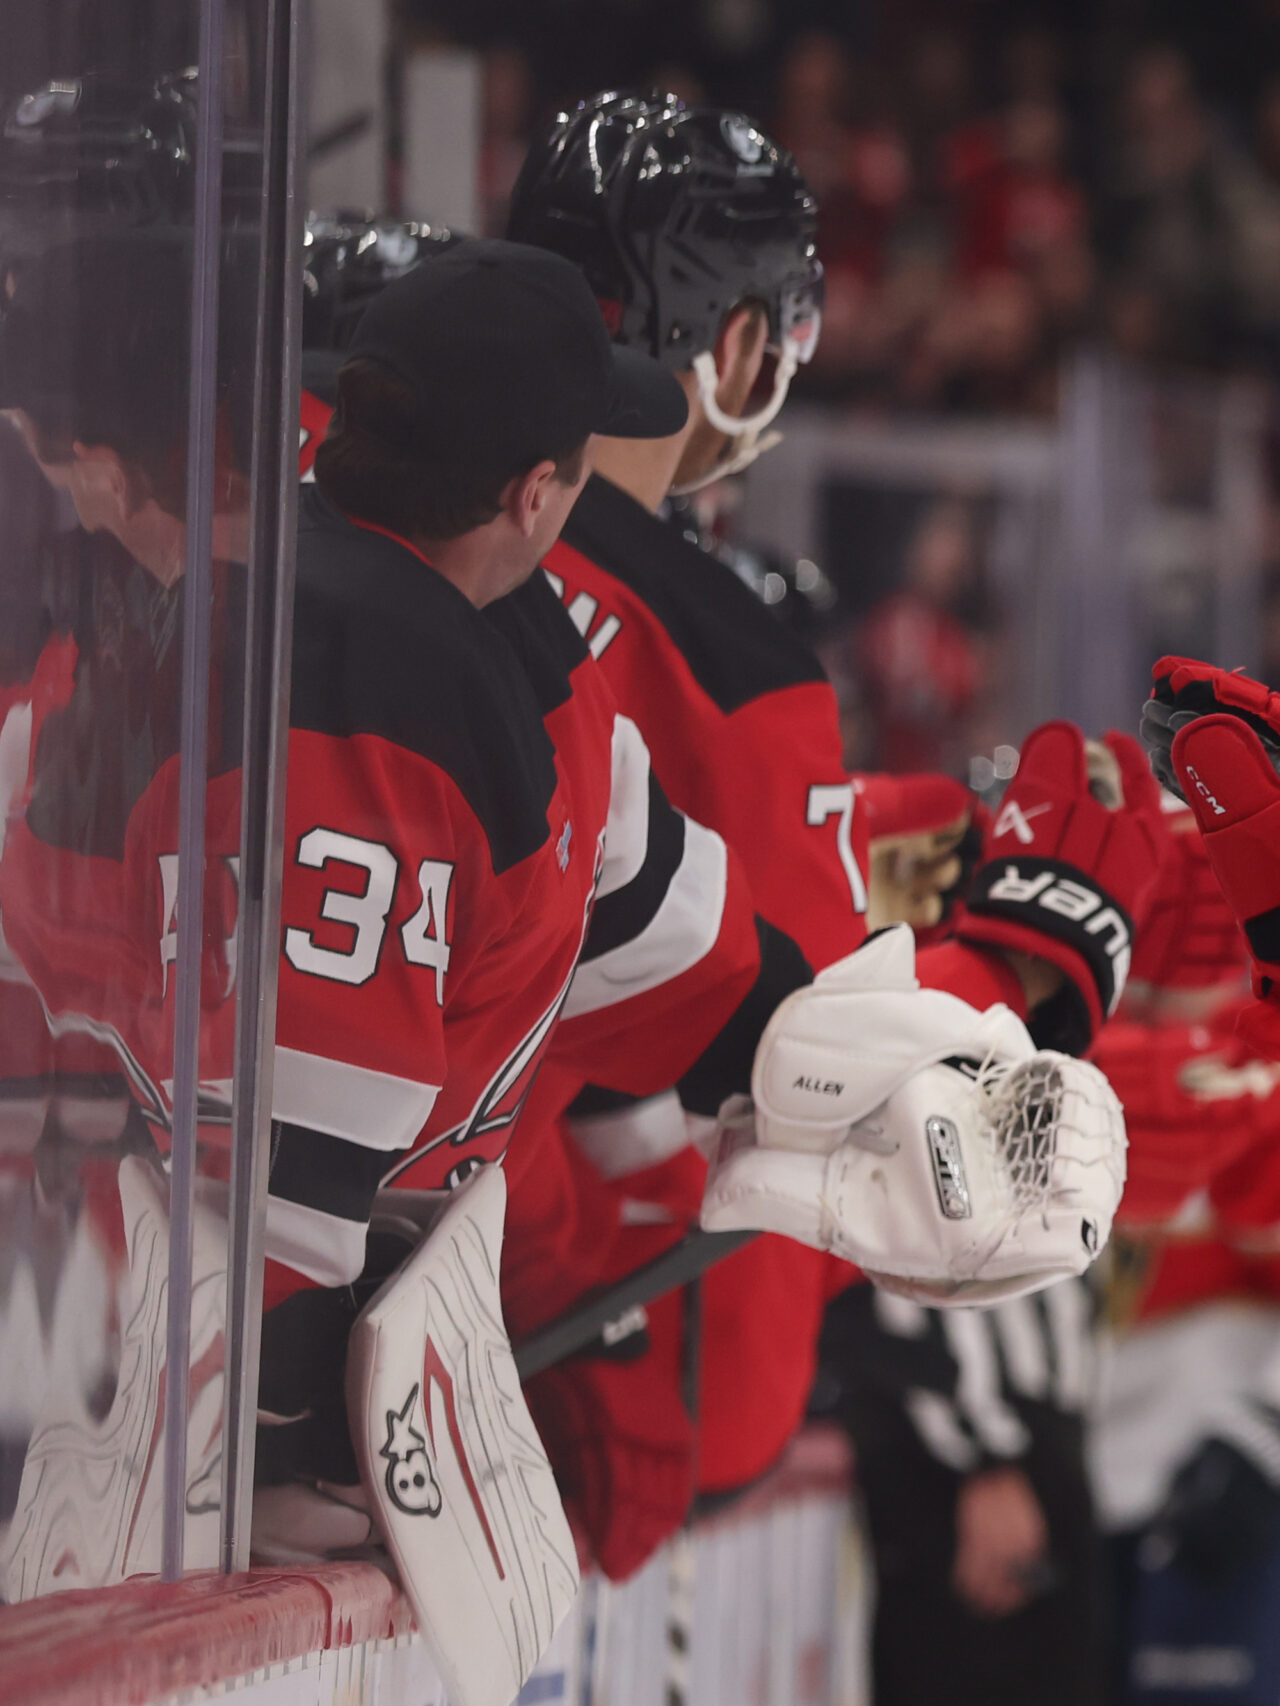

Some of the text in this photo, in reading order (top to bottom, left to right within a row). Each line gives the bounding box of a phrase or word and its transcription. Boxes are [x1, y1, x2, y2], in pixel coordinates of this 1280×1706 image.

[1186, 765, 1226, 816] CCM
[284, 826, 455, 1007] 34
[792, 1075, 845, 1097] ALLEN
